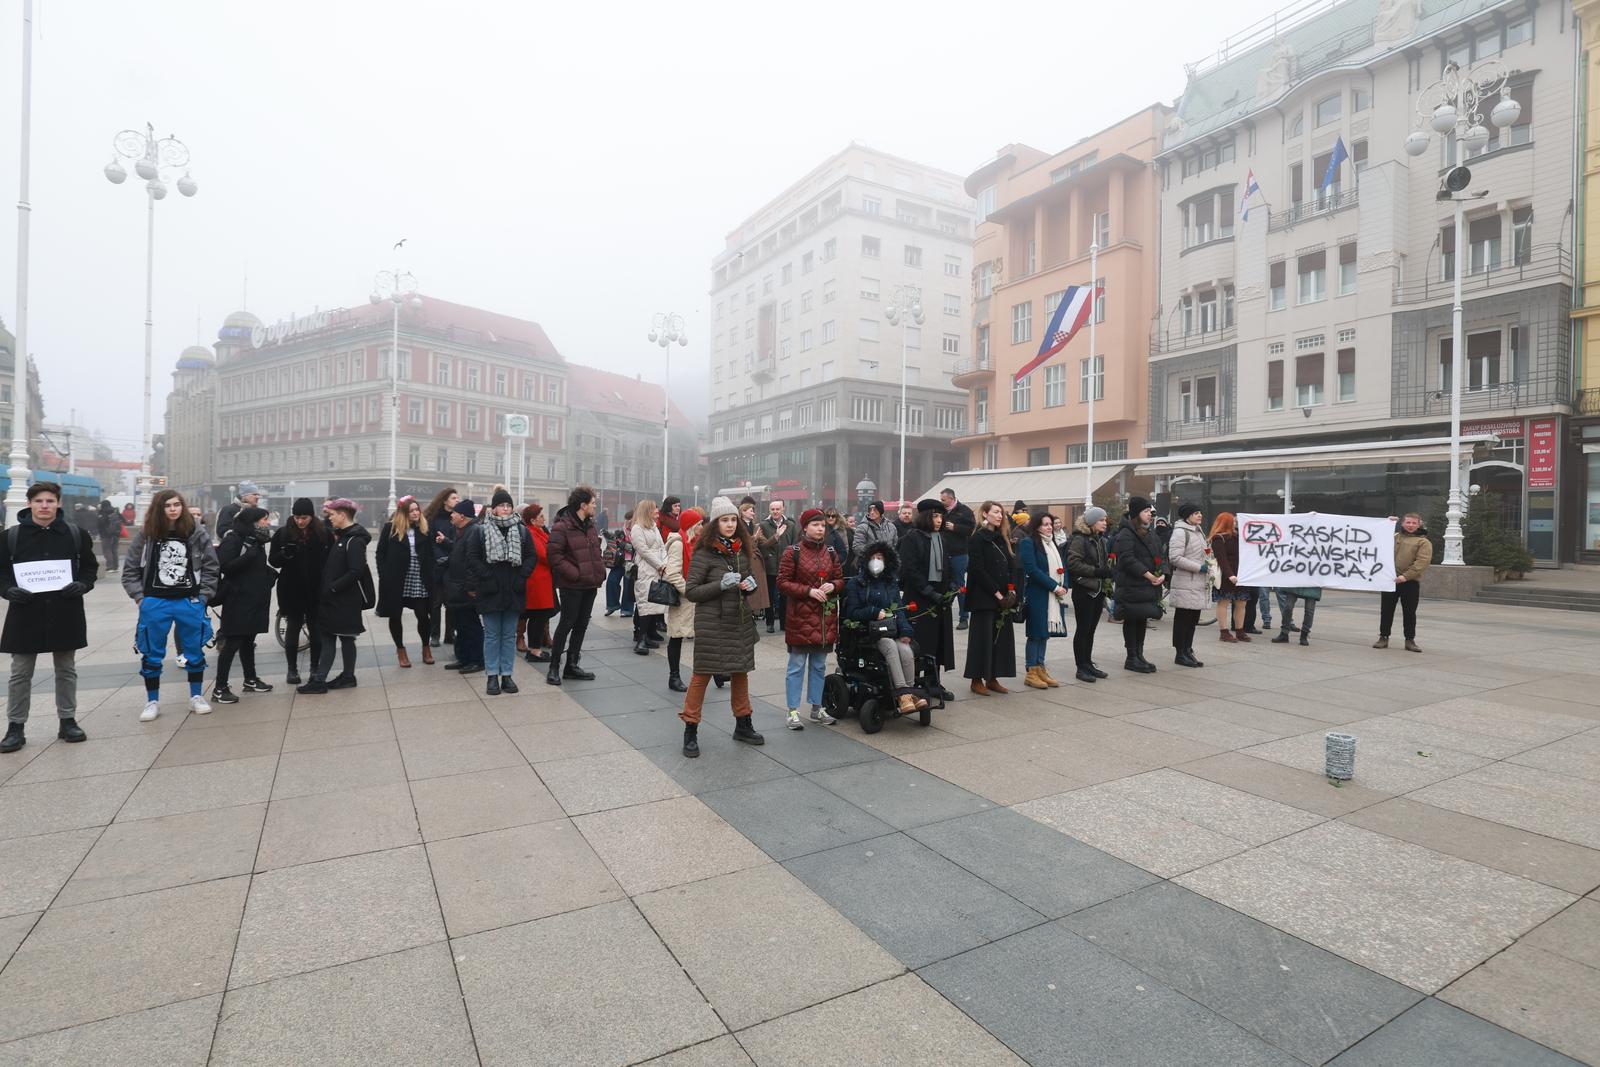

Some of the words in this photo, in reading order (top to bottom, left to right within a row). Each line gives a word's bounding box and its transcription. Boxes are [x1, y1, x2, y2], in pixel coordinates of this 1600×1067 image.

[1246, 523, 1281, 543] ZA
[20, 570, 41, 578] CRKVU
[1268, 559, 1384, 582] UGOVORA!
